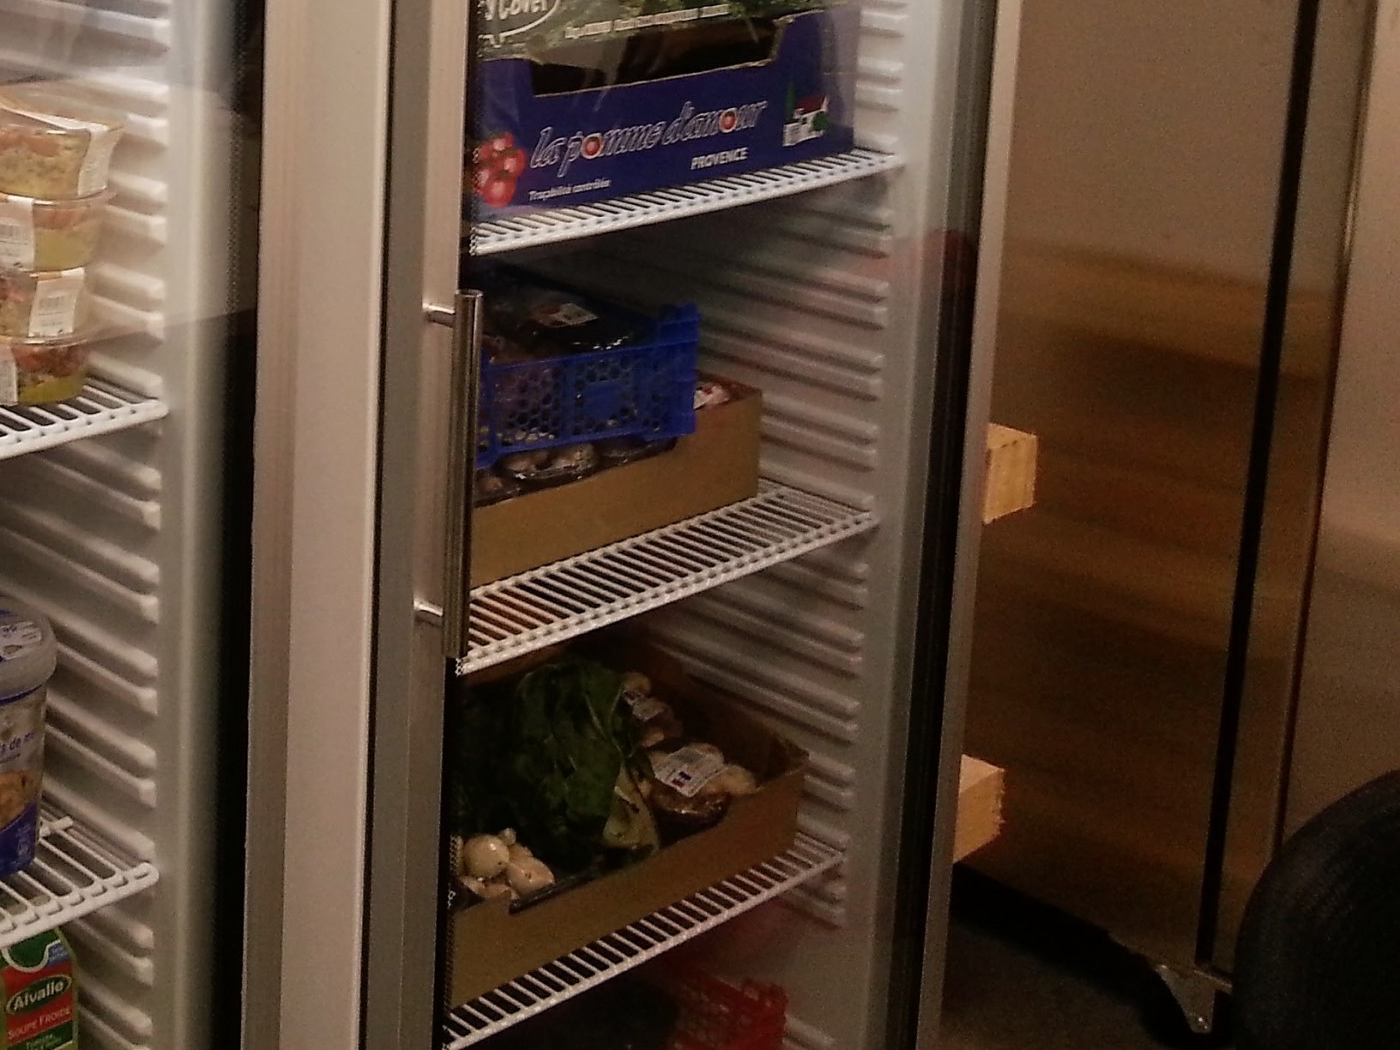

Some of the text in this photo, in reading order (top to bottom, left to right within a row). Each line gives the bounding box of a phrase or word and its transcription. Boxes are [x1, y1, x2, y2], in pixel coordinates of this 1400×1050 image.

[557, 120, 667, 179] pomme
[690, 147, 749, 171] PROVENCE
[13, 979, 65, 1012] Alvalle
